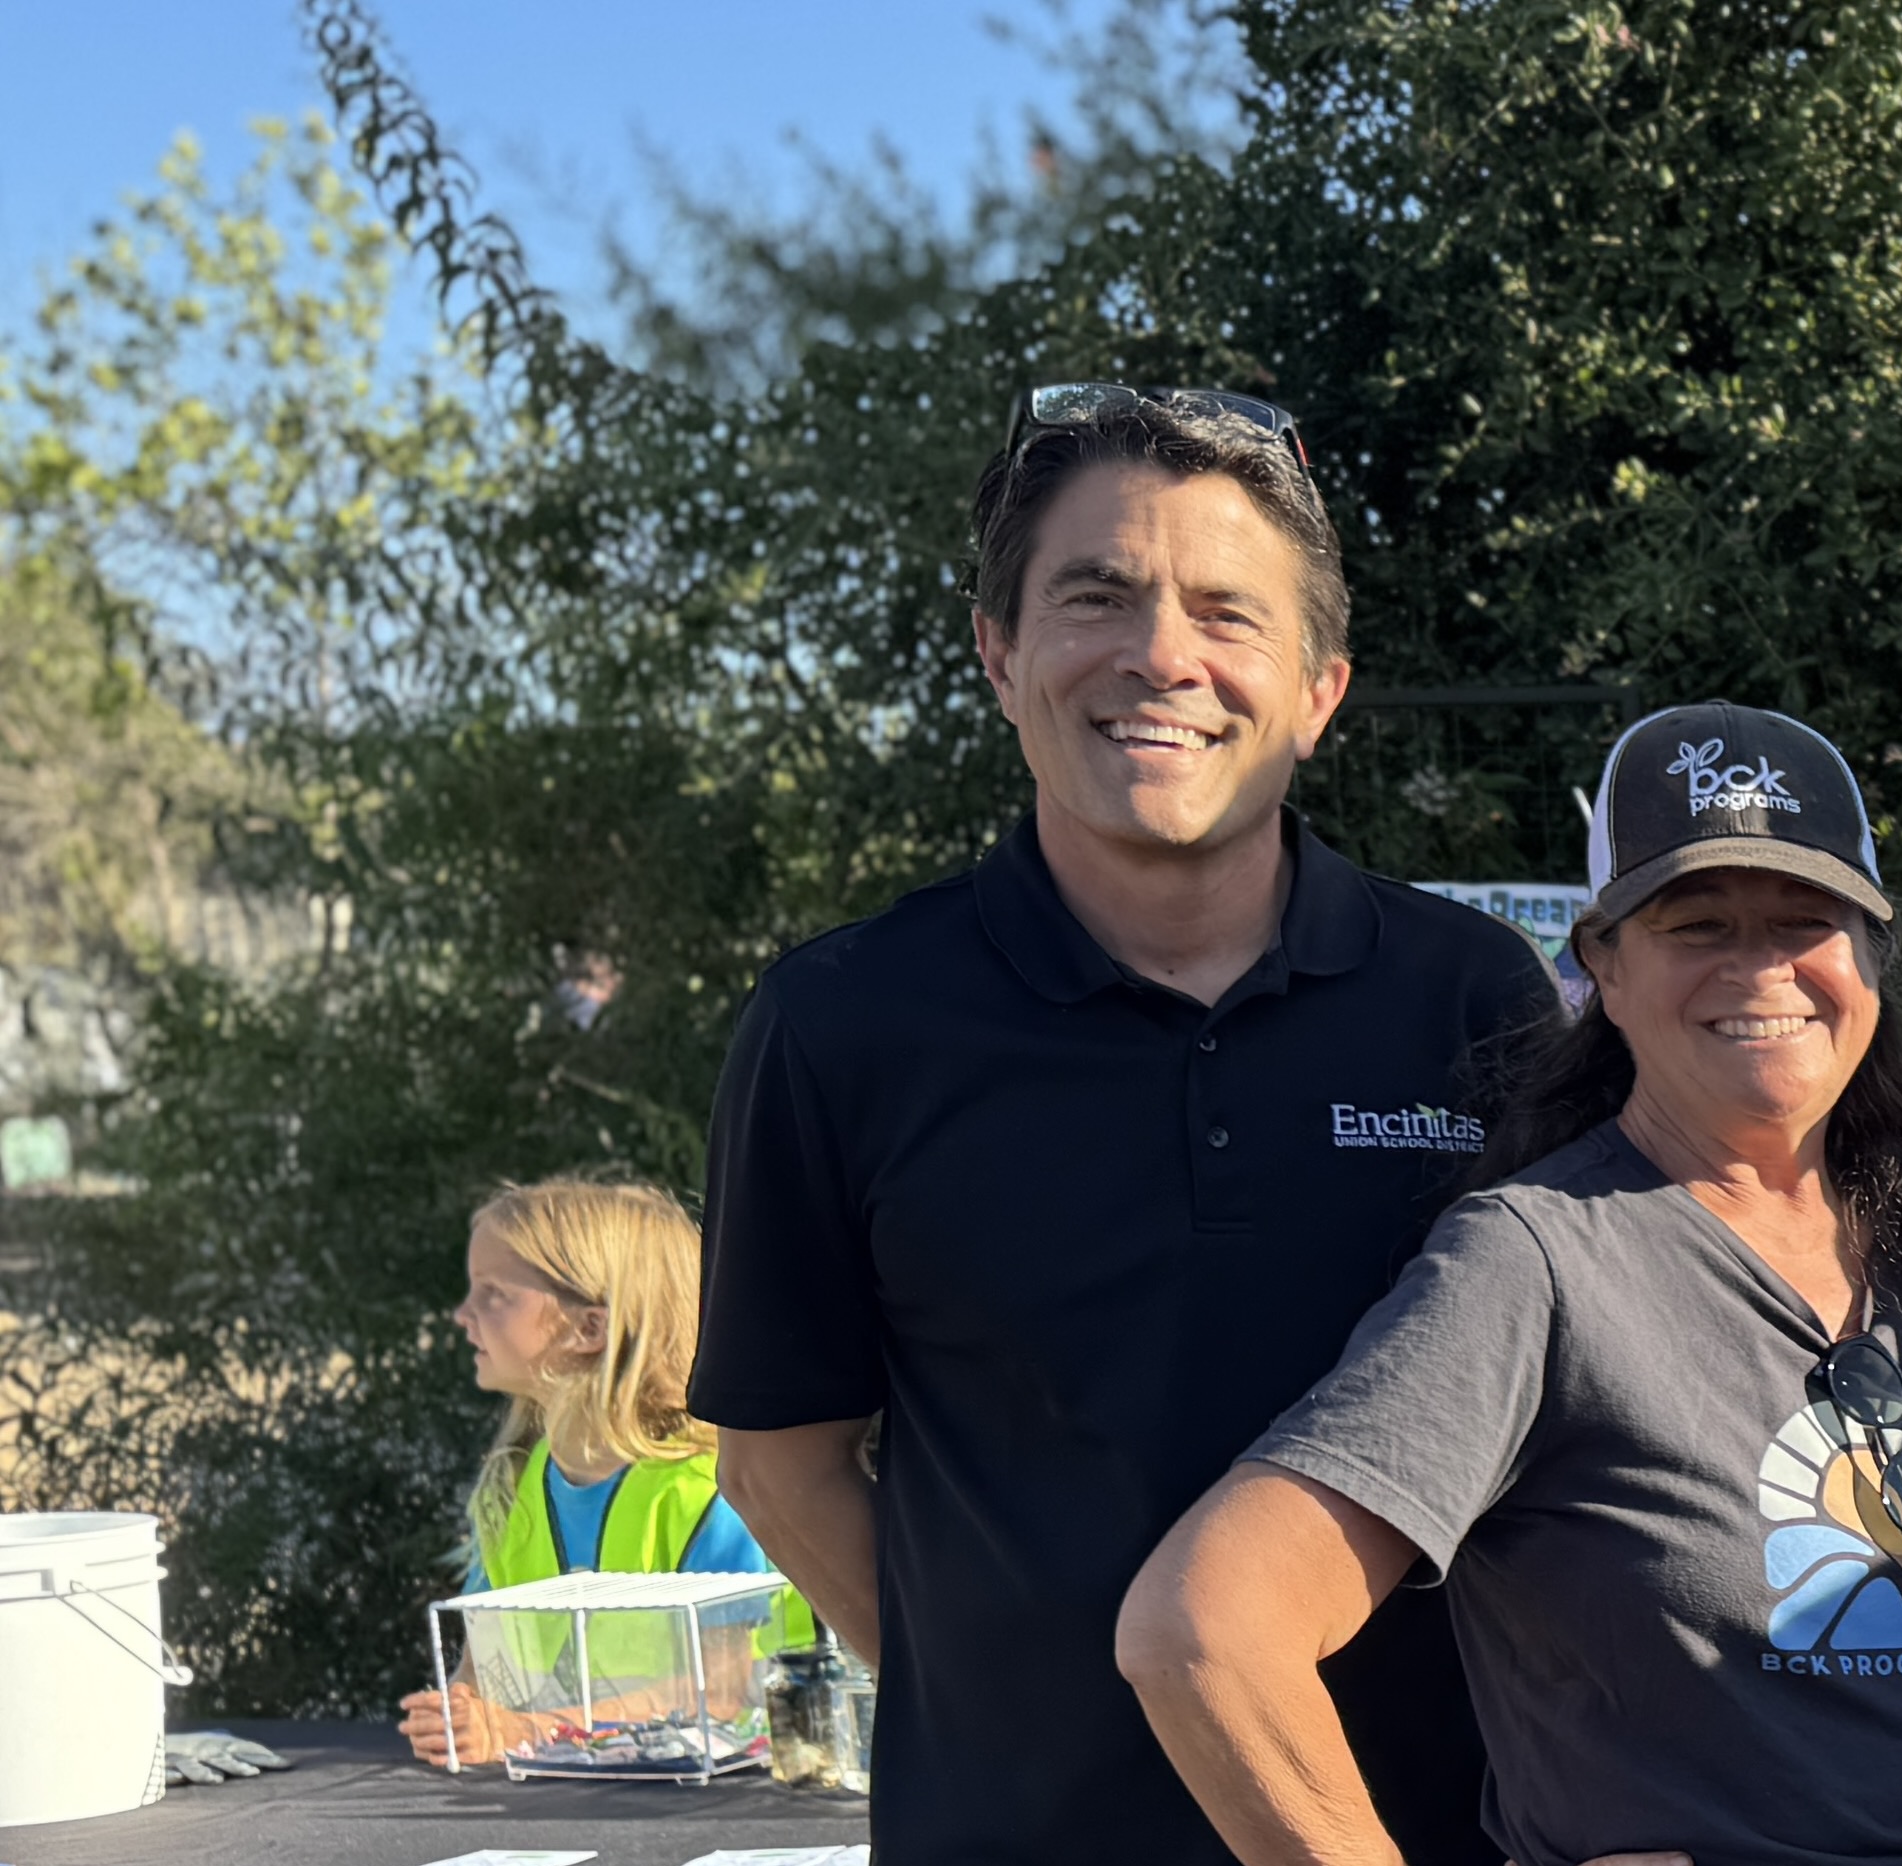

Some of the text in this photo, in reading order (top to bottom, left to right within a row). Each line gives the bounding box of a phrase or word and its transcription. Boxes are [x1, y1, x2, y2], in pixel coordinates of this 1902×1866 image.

[1689, 756, 1791, 796] bck
[1689, 791, 1801, 816] programs
[1330, 1103, 1485, 1141] Encinitas
[1334, 1136, 1485, 1153] UNION SCHOOL DISTRICT
[1760, 1653, 1832, 1675] BCK
